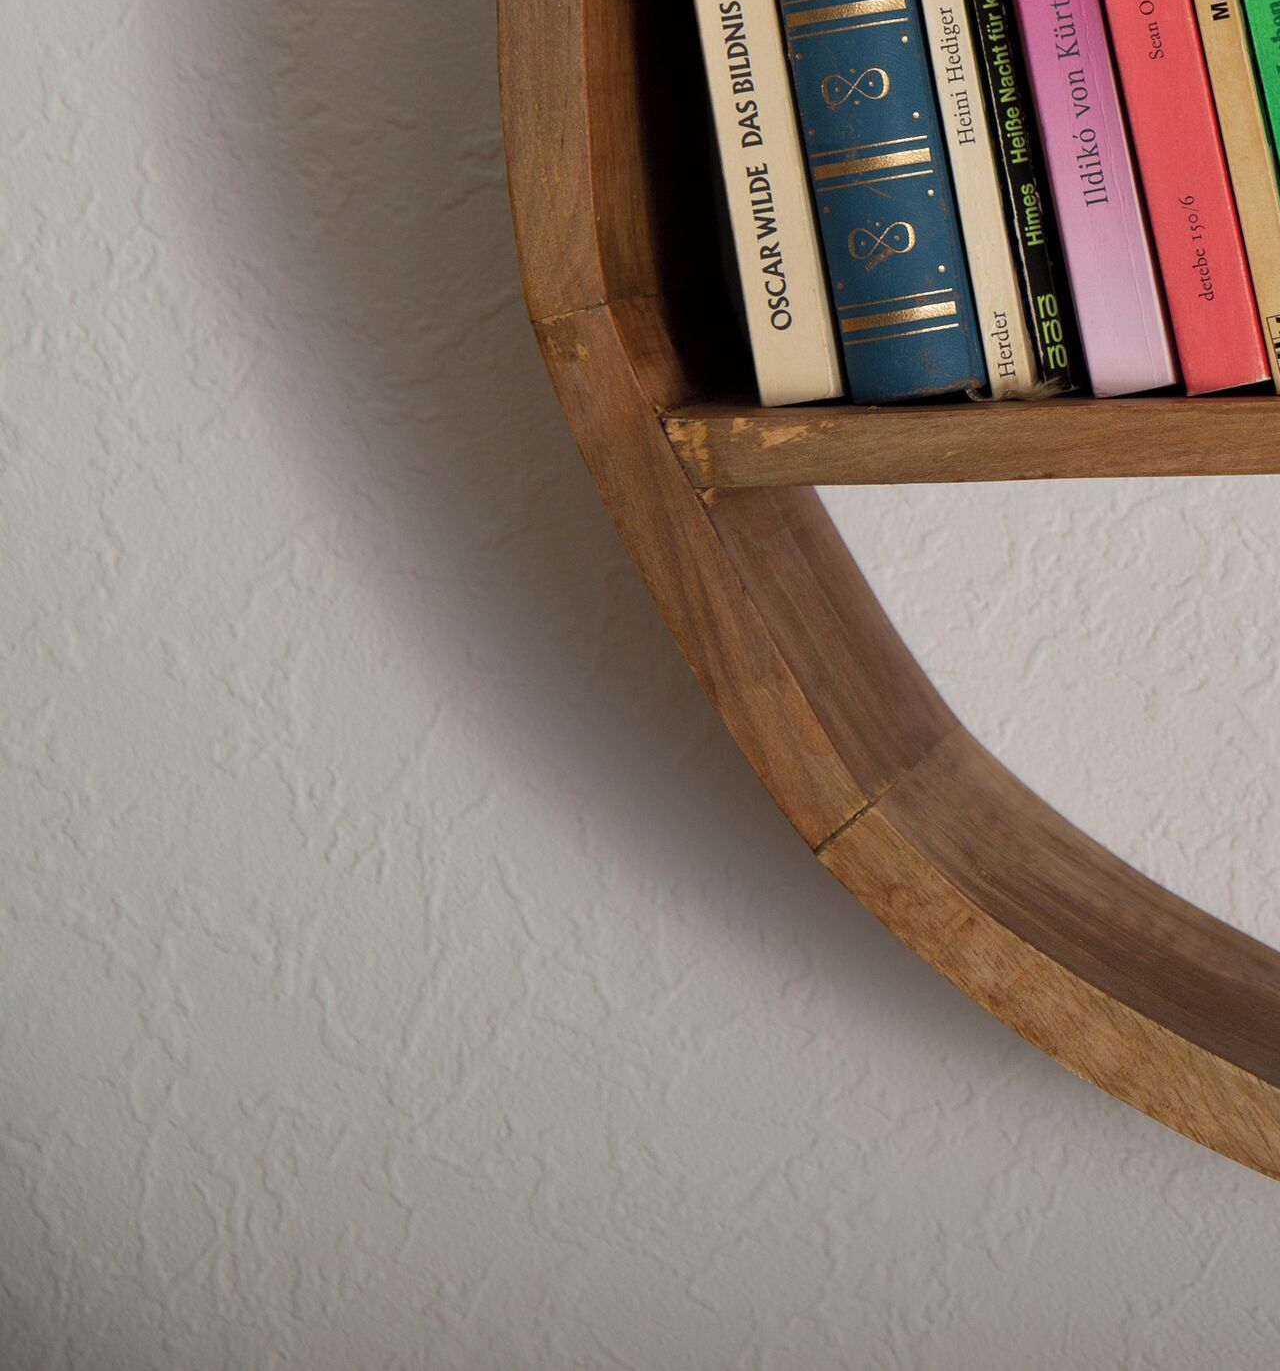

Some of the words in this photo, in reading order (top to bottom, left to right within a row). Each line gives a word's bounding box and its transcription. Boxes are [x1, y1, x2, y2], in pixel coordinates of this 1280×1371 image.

[720, 0, 755, 96] BILDNIS
[940, 6, 966, 85] Hediger
[985, 10, 1007, 42] für
[1148, 21, 1164, 61] Sean
[992, 42, 1018, 103] Nacht
[1068, 68, 1091, 119] von
[736, 99, 764, 149] DAS
[951, 90, 976, 146] Heini
[1005, 105, 1029, 165] Heiße
[1072, 128, 1108, 207] Ildikó
[746, 162, 777, 243] WILDE
[1021, 182, 1045, 247] Himes
[1178, 195, 1206, 241] 150/6
[760, 240, 793, 332] OSCAR
[1192, 248, 1215, 302] detebe
[1037, 293, 1058, 318] ro
[1042, 319, 1063, 344] ro
[991, 311, 1016, 379] Herder
[1049, 344, 1068, 370] ro
